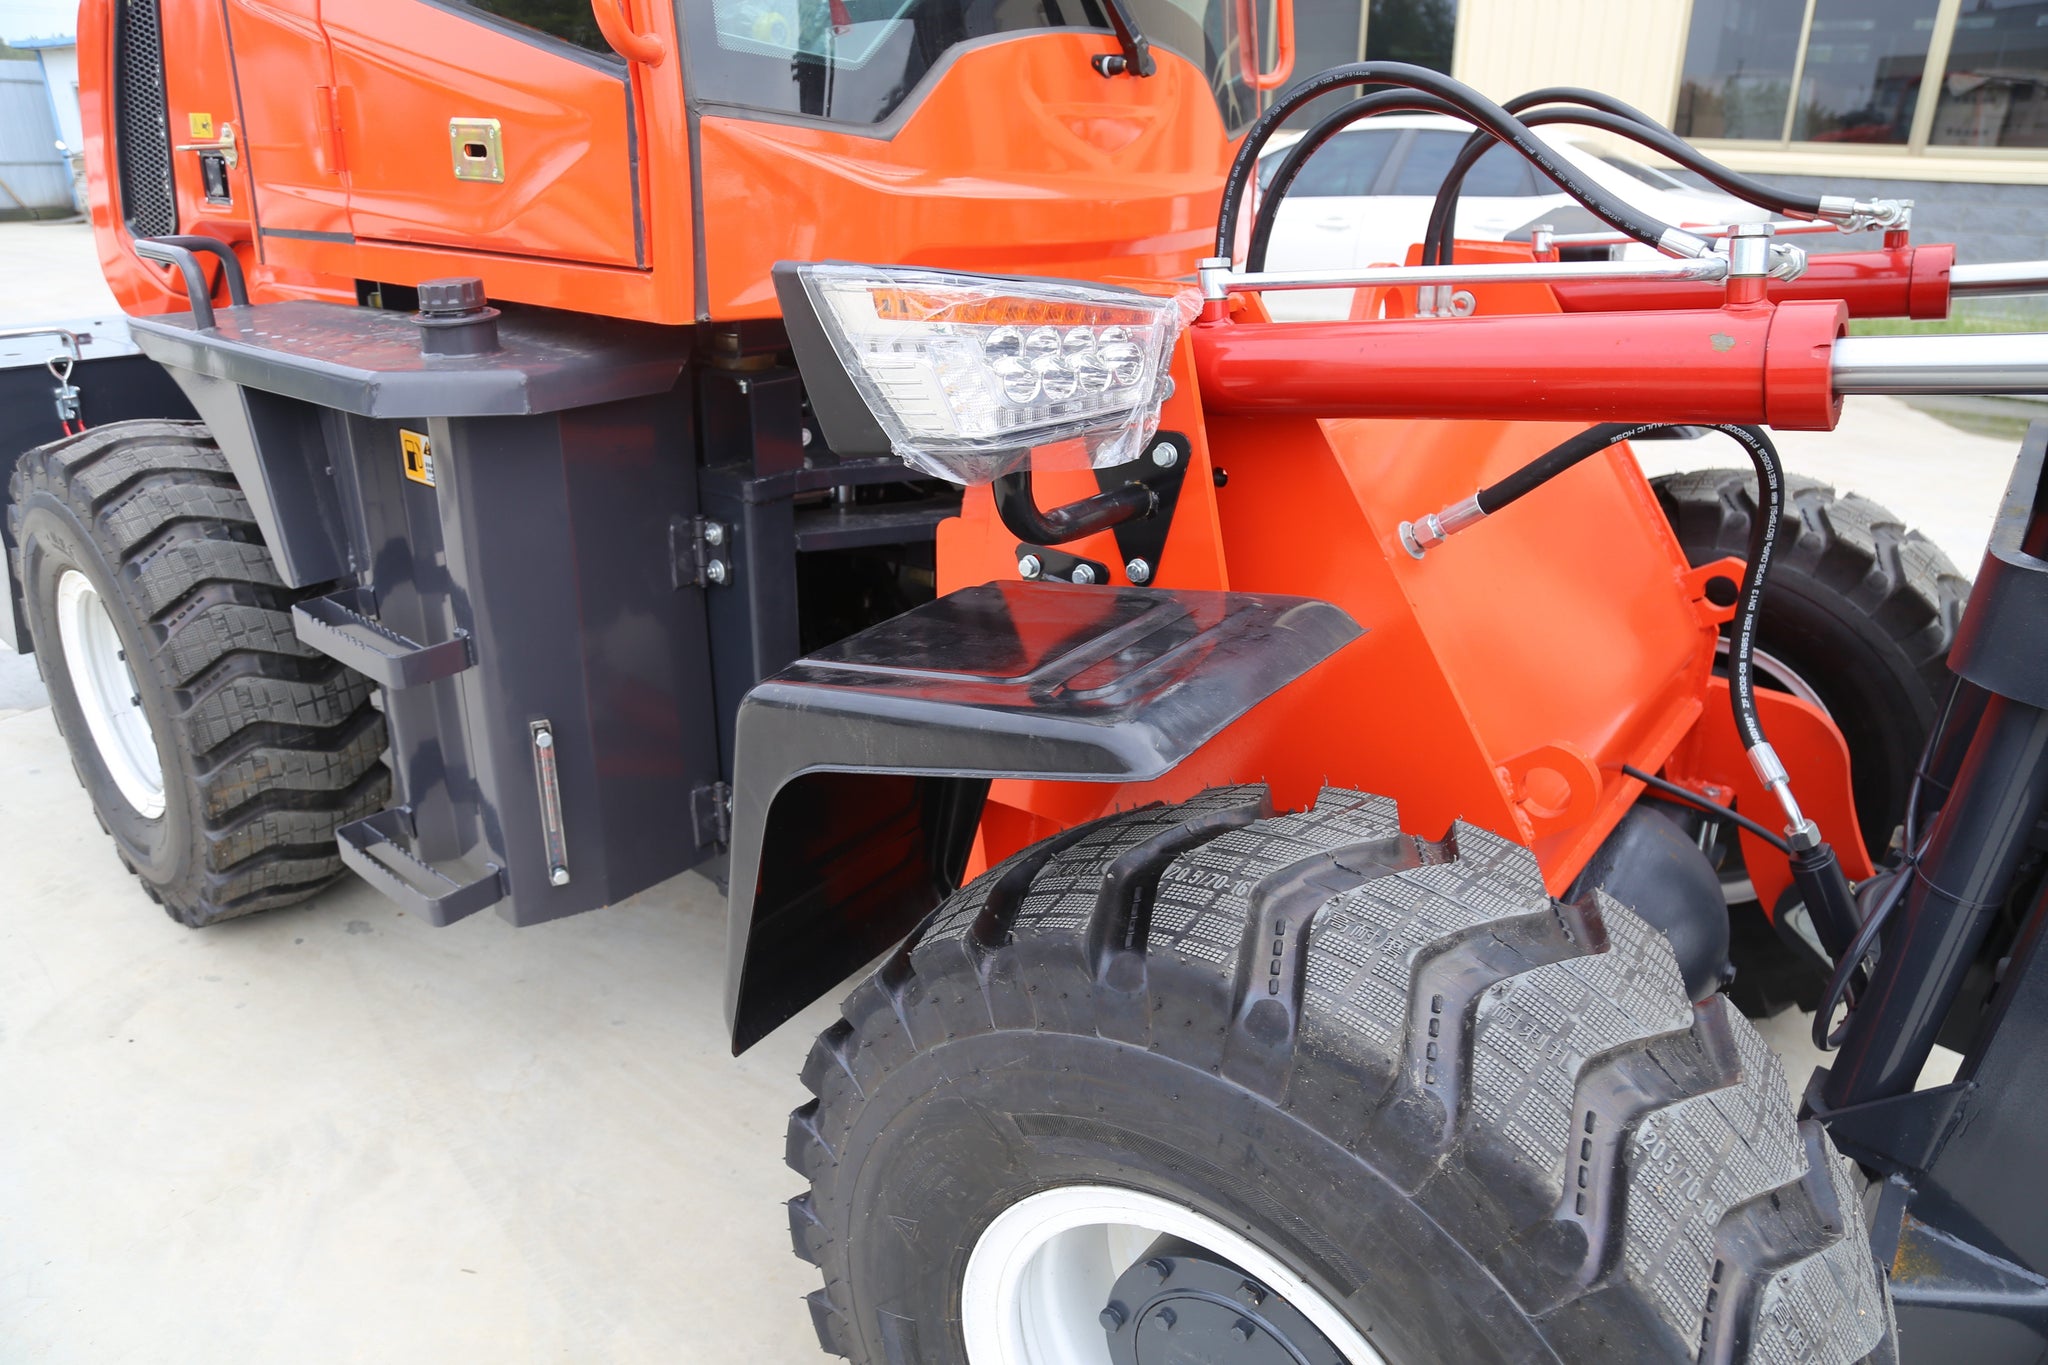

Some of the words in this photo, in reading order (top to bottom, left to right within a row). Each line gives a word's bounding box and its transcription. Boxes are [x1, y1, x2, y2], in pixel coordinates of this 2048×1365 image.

[1610, 429, 1635, 443] HOSE
[1748, 589, 1760, 611] DN13
[1743, 614, 1753, 631] 2SN
[1165, 865, 1252, 897] 20.5/70-16
[1322, 910, 1410, 960] 高耐磨
[1492, 1002, 1570, 1073] 耐刺扎
[1641, 1130, 1722, 1228] 20.5/70-16
